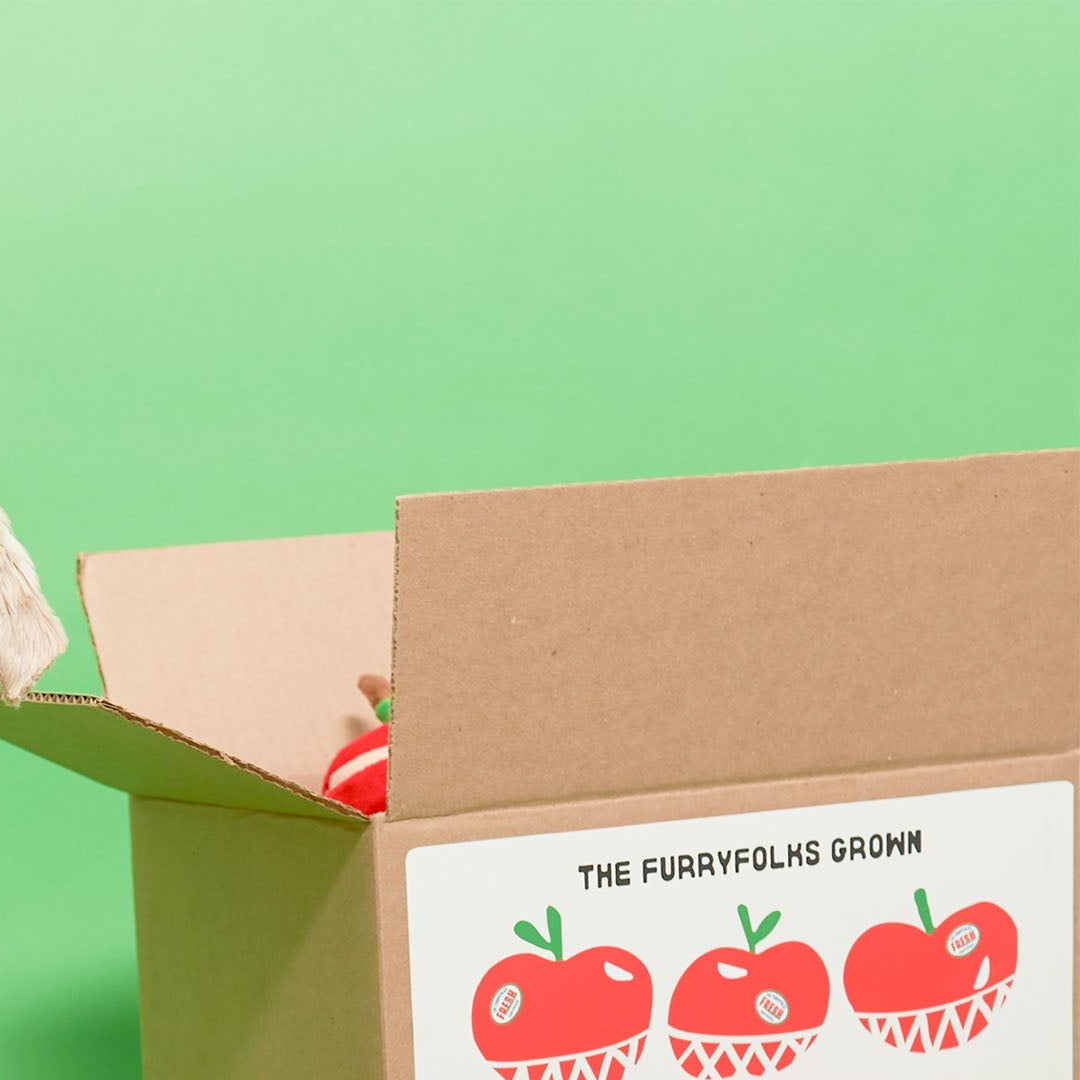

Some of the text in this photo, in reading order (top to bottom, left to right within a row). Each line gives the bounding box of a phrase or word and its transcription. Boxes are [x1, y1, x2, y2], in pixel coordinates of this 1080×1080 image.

[578, 829, 922, 890] THE FURRYFOLKS GROWN
[951, 930, 976, 952] FRESH
[495, 989, 517, 1020] FRESH
[759, 996, 784, 1019] FRESH
